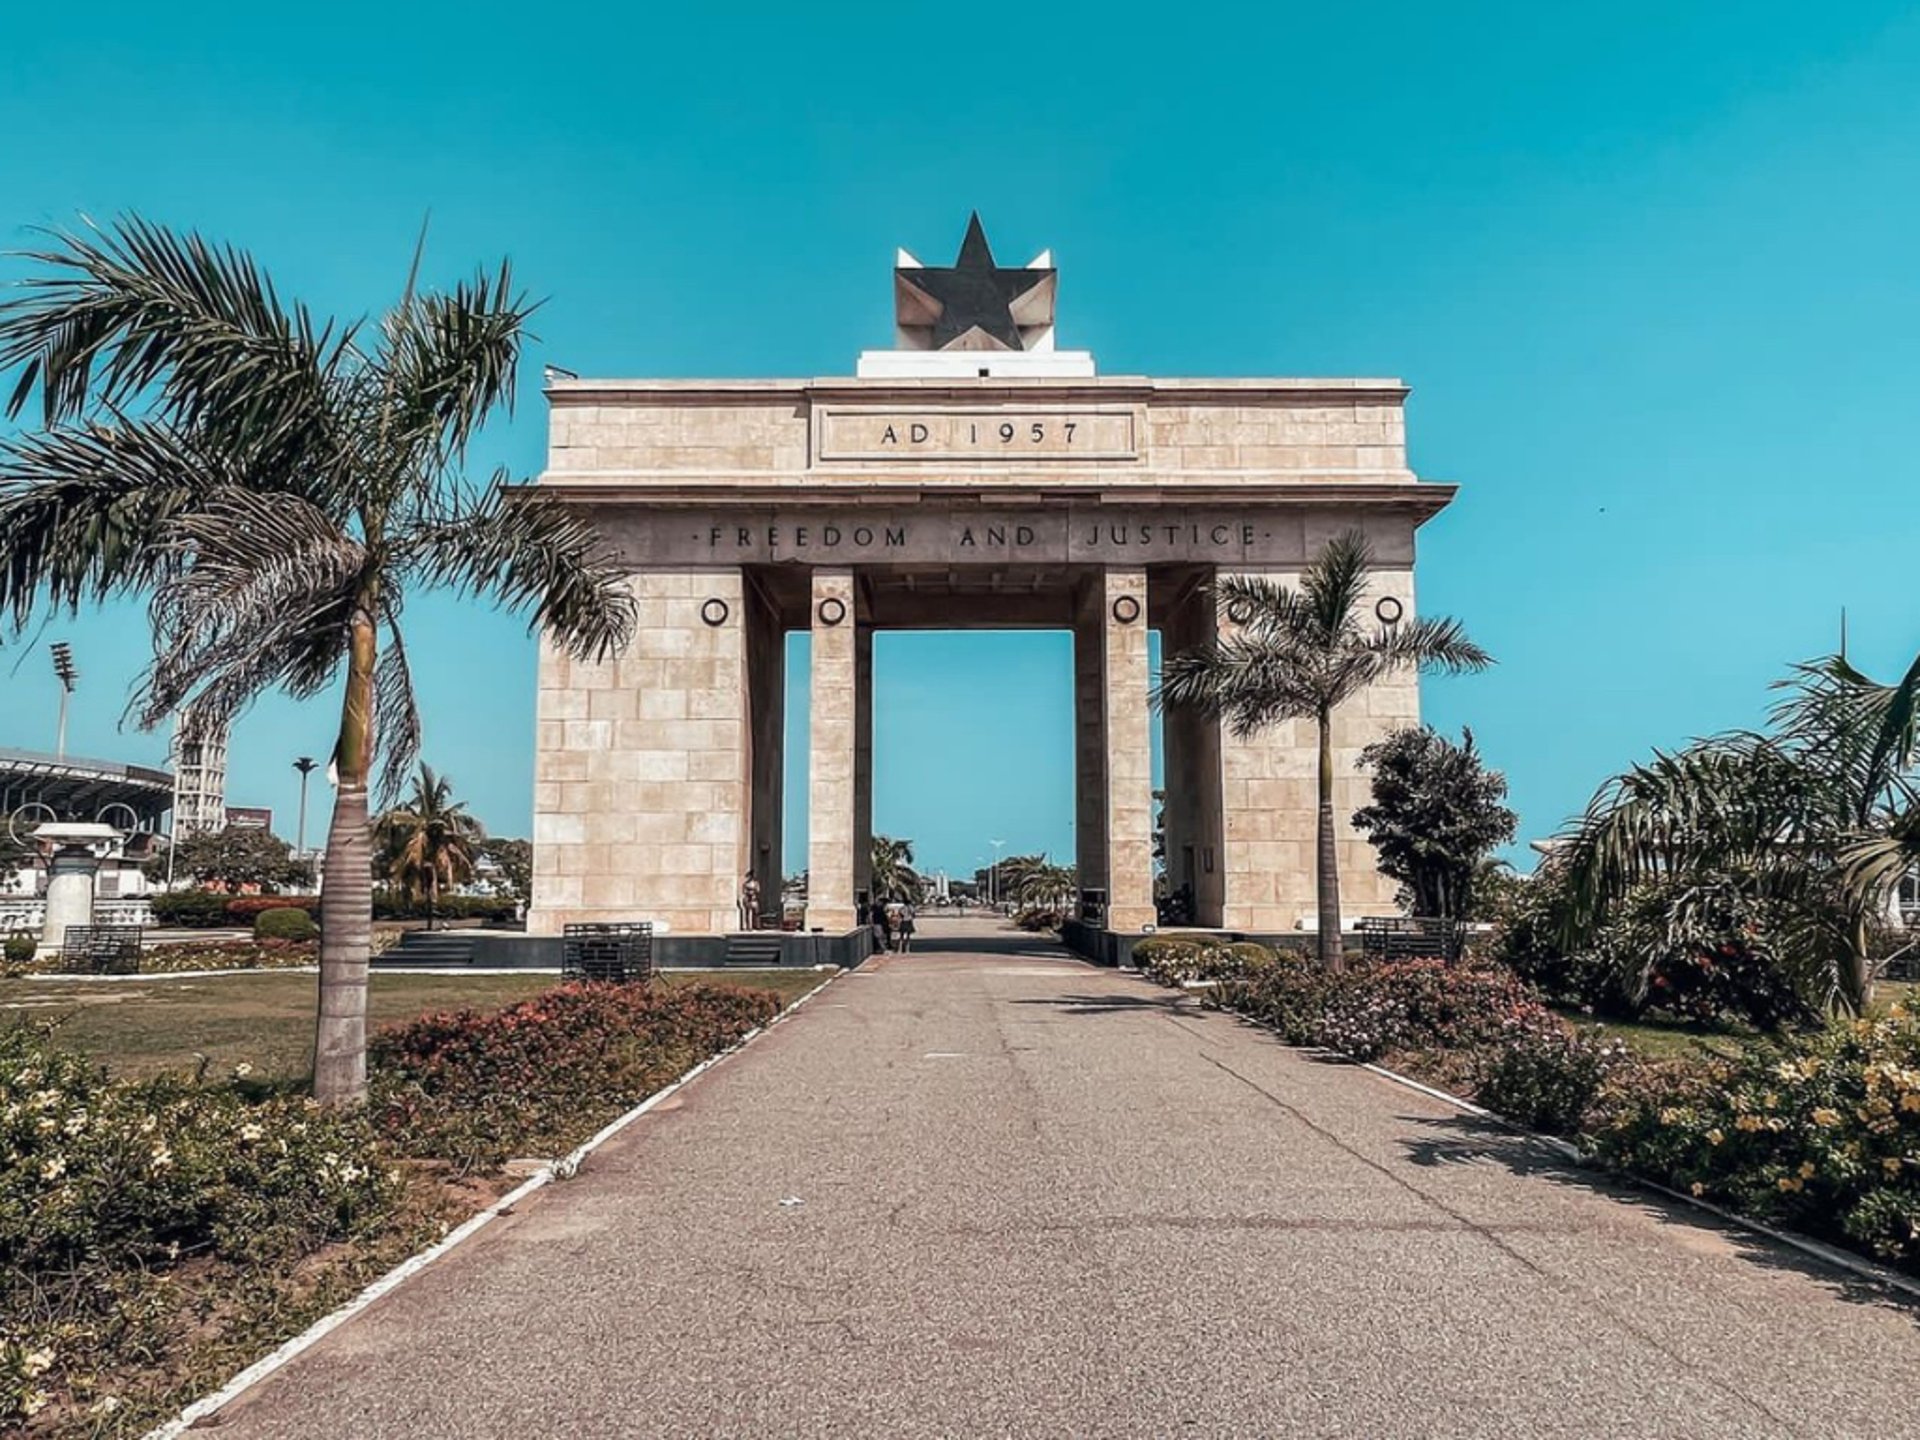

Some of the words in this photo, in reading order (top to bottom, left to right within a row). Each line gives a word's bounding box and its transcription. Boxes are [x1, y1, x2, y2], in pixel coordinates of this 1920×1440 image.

[881, 424, 929, 444] AD
[970, 423, 1077, 444] 1957
[710, 526, 906, 547] FREEDOM
[961, 525, 1035, 546] AND
[1087, 524, 1256, 545] JUSTICE
